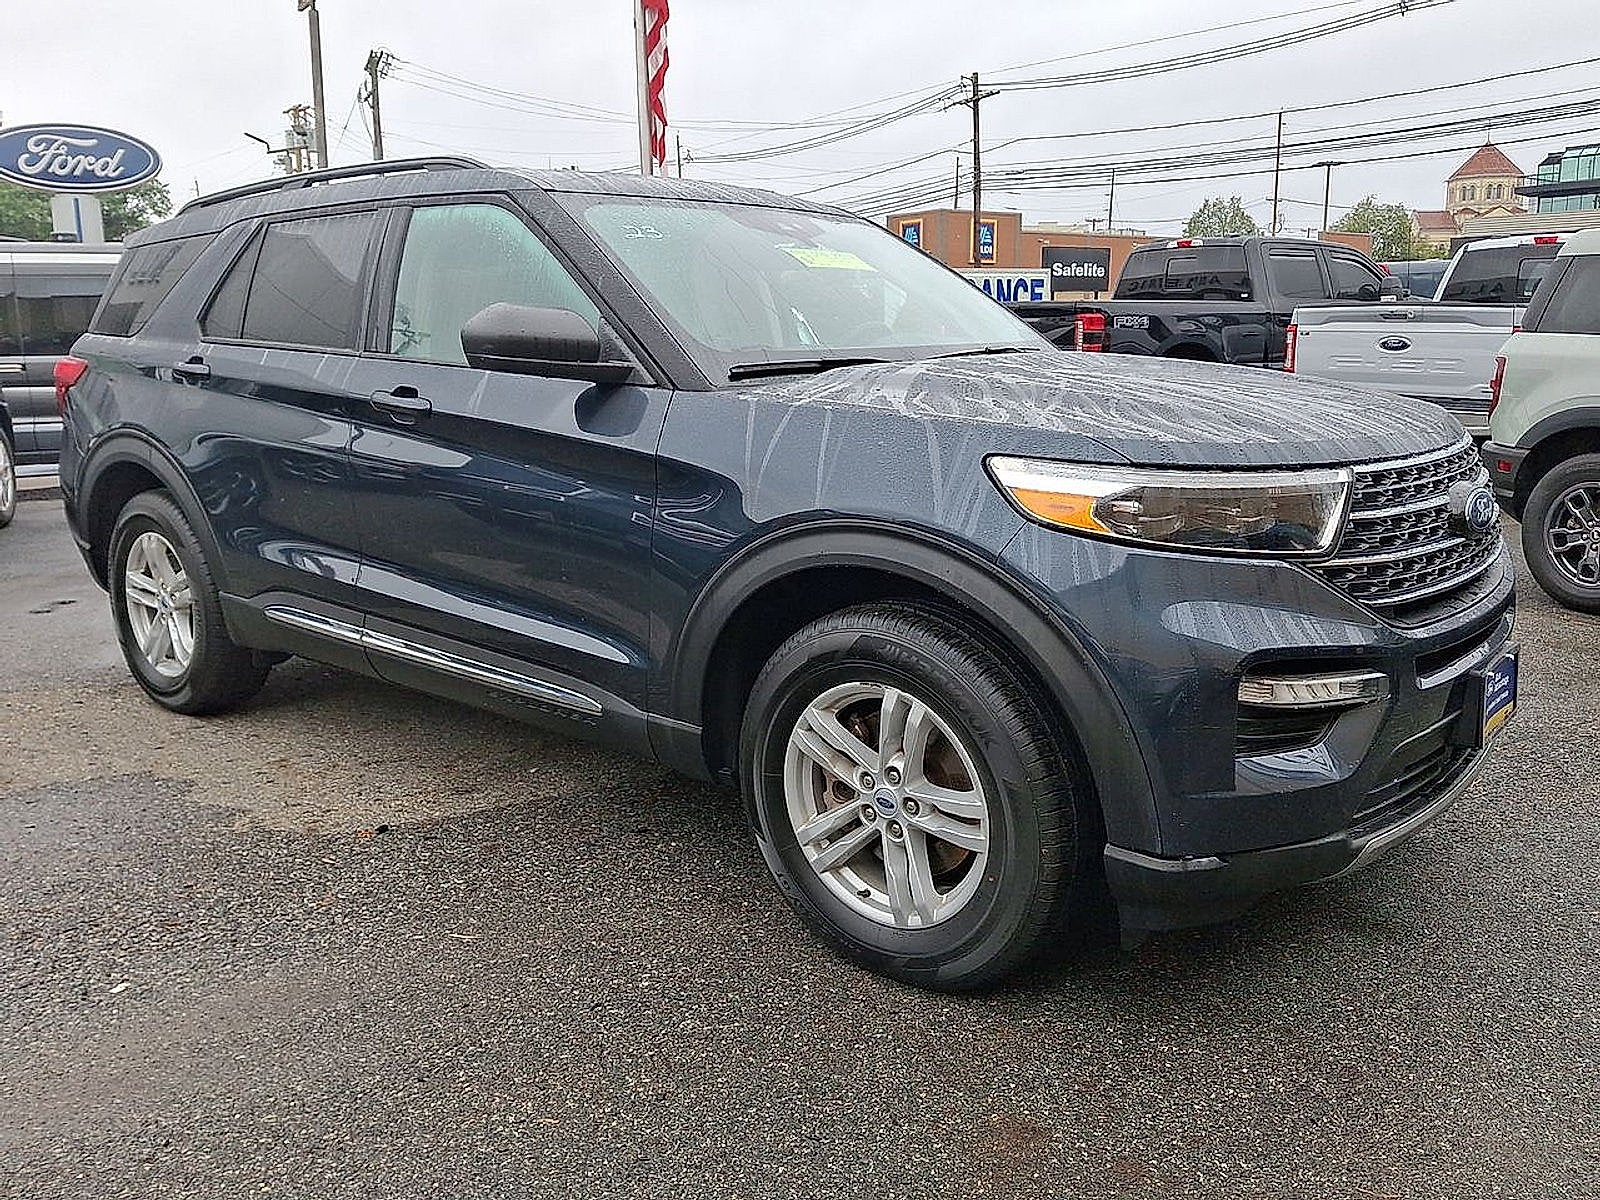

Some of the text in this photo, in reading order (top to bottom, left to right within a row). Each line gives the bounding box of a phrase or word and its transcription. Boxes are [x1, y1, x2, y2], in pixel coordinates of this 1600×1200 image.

[17, 133, 126, 178] Ford
[1052, 262, 1106, 278] Safelite
[968, 278, 1045, 302] ANCE
